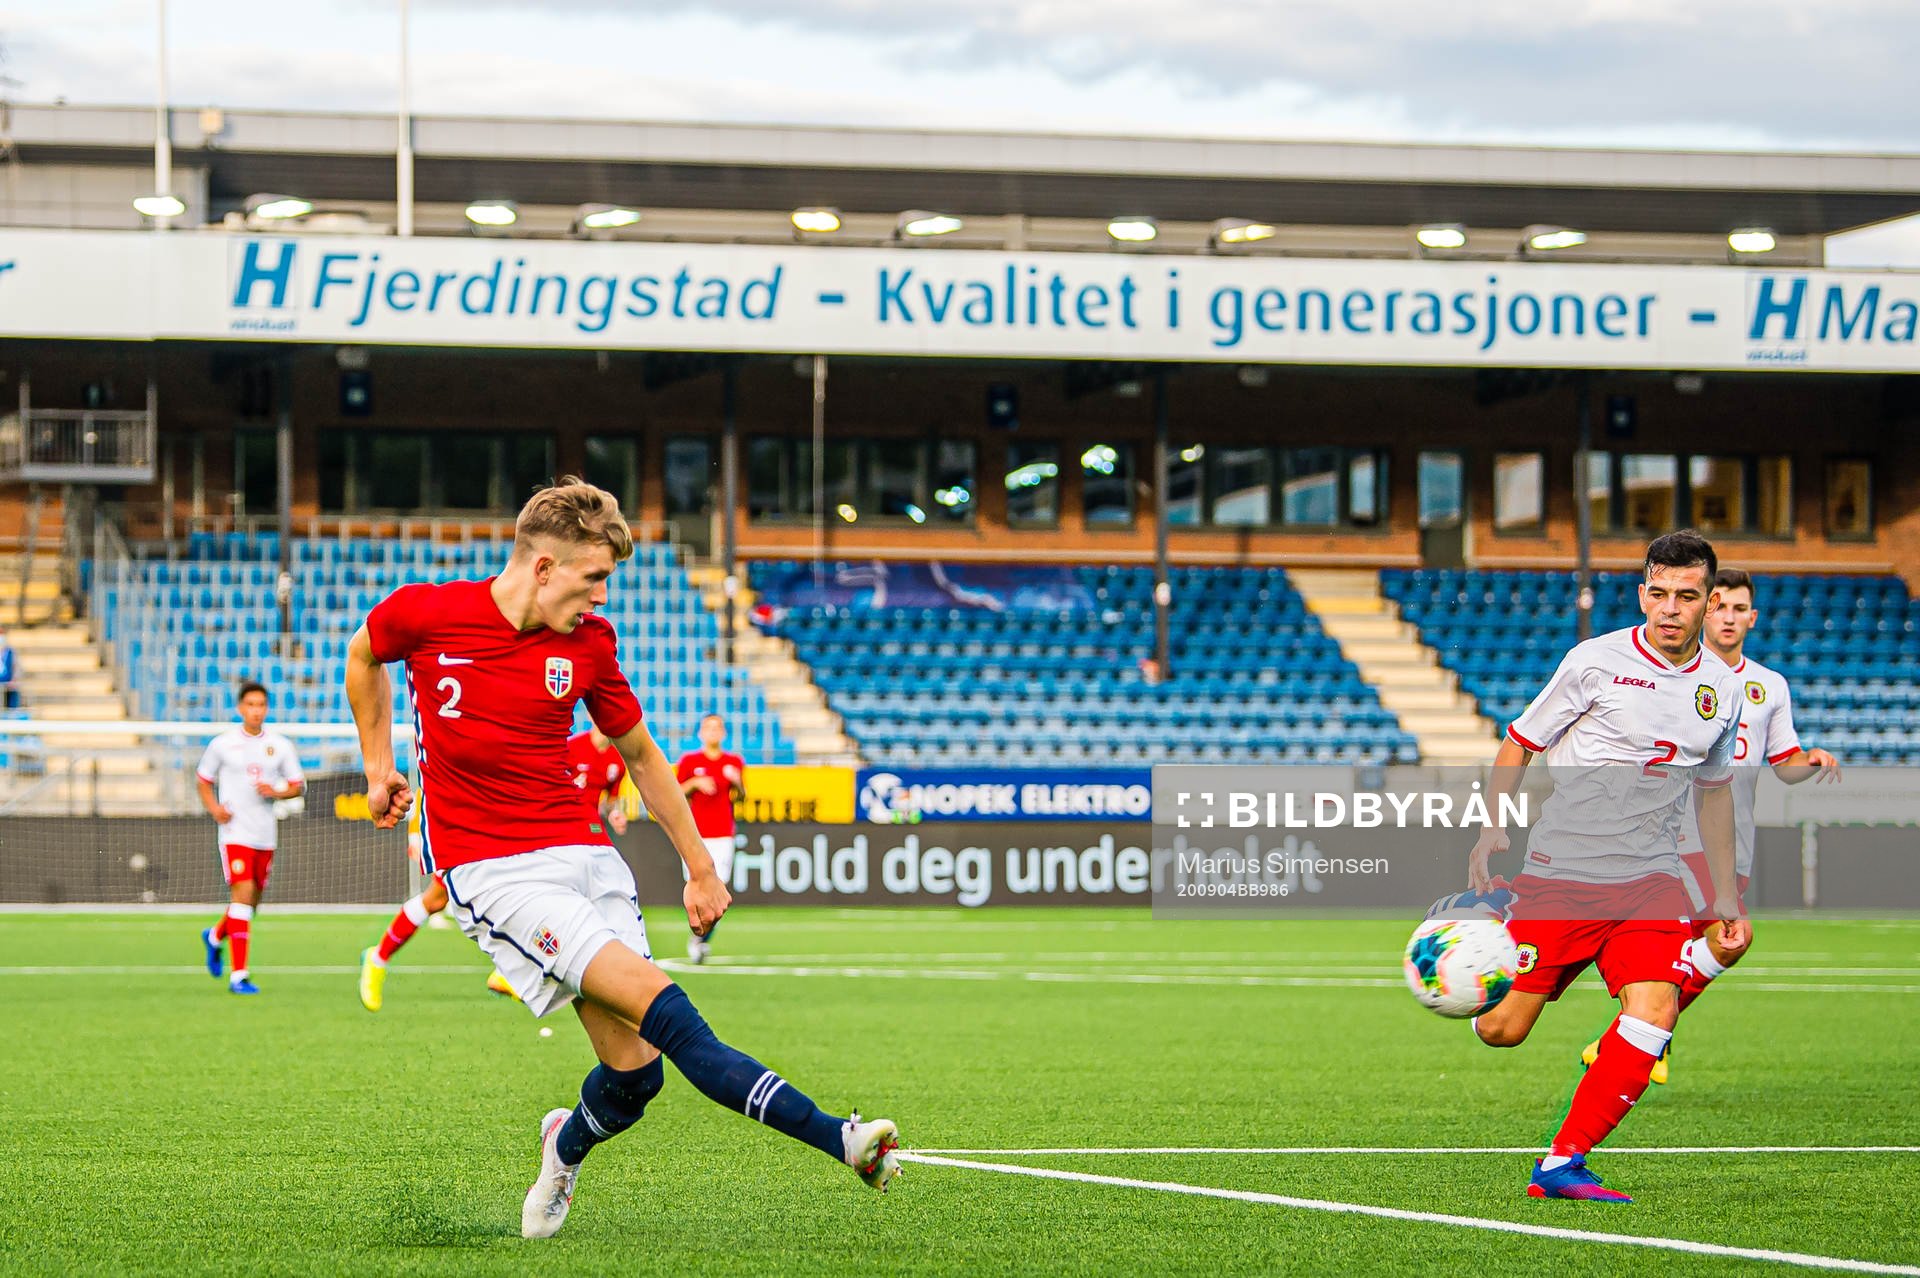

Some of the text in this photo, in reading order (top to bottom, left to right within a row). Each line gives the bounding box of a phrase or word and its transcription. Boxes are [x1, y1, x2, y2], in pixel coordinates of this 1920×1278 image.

[233, 241, 296, 308] H
[311, 253, 783, 333] Fjerdingstad
[878, 265, 1137, 329] Kvalitet
[1168, 270, 1179, 330] i
[1209, 275, 1655, 351] generasjoner
[1749, 277, 1808, 340] H
[1818, 284, 1920, 343] Ma
[436, 676, 462, 718] 2
[1613, 675, 1656, 690] LEGEA
[1643, 740, 1679, 778] 2
[1021, 784, 1151, 815] ELEKTRO
[733, 834, 1324, 907] Hold deg underholdt
